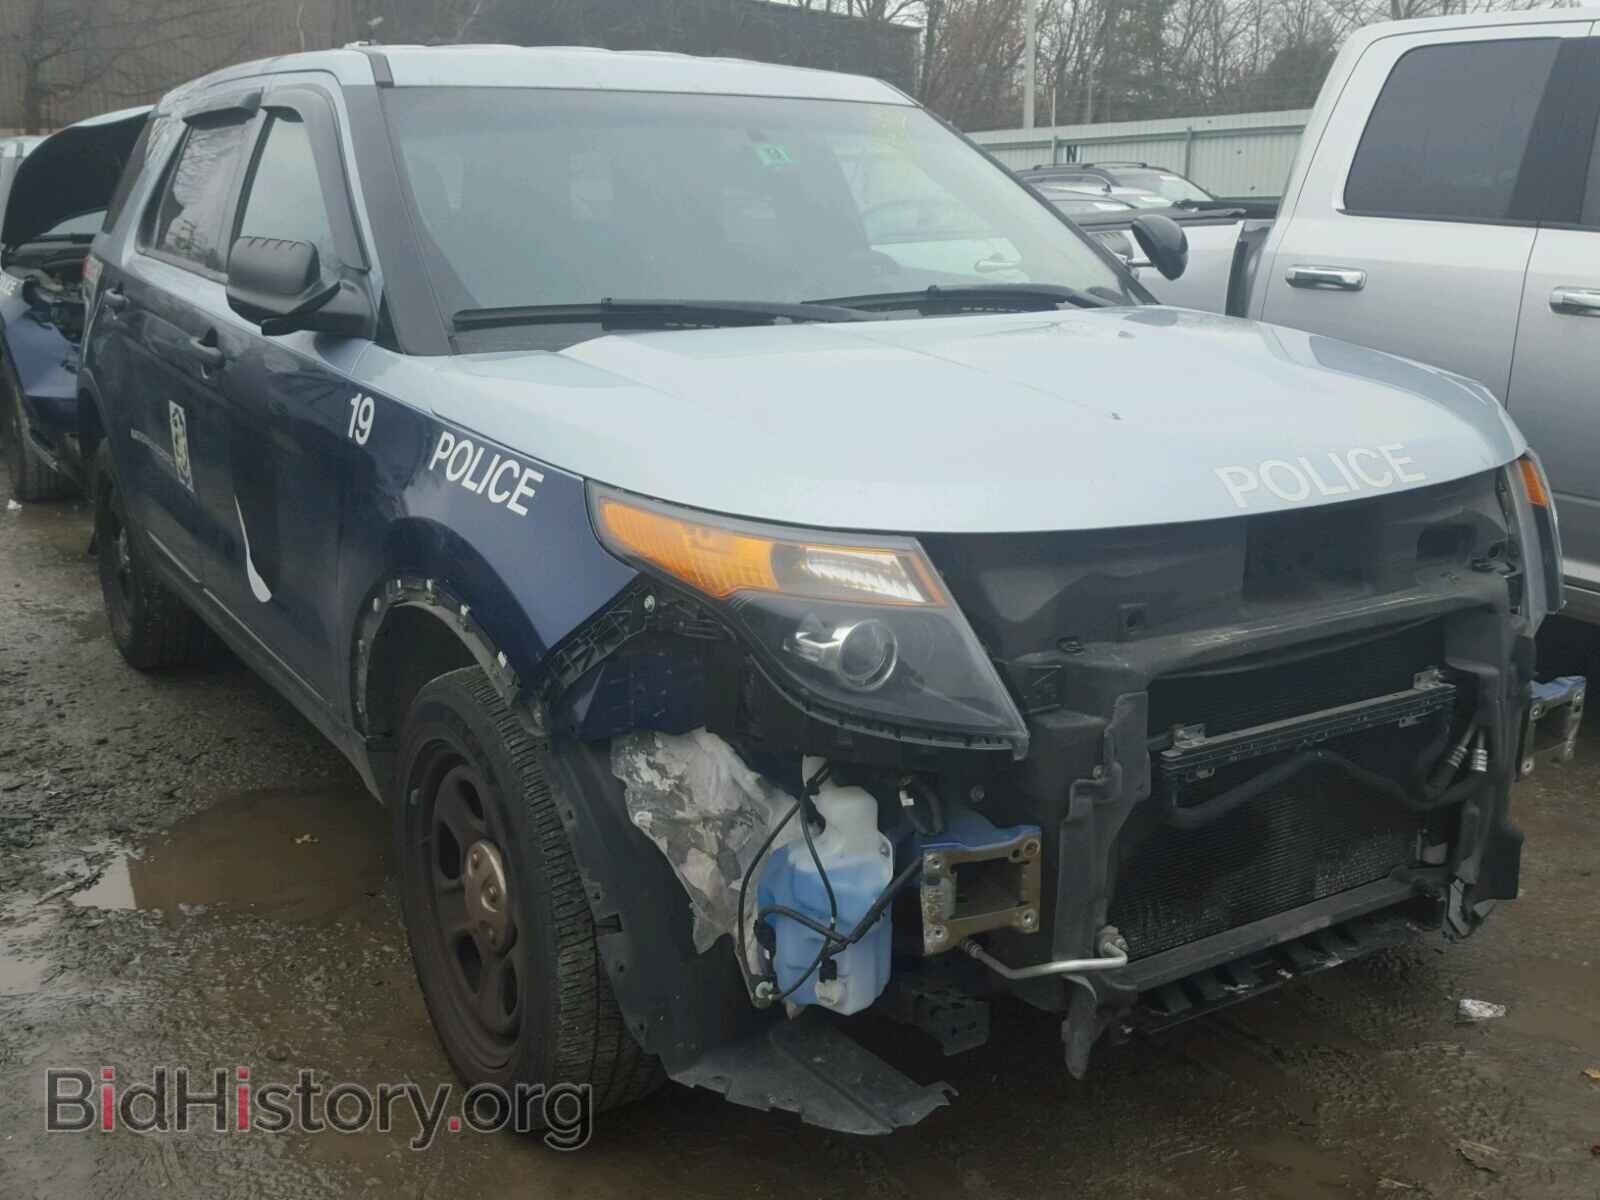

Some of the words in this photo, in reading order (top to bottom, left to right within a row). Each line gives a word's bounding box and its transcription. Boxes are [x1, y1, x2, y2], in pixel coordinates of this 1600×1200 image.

[348, 393, 375, 445] 19
[428, 431, 545, 516] POLICE
[1213, 443, 1427, 508] POLICE
